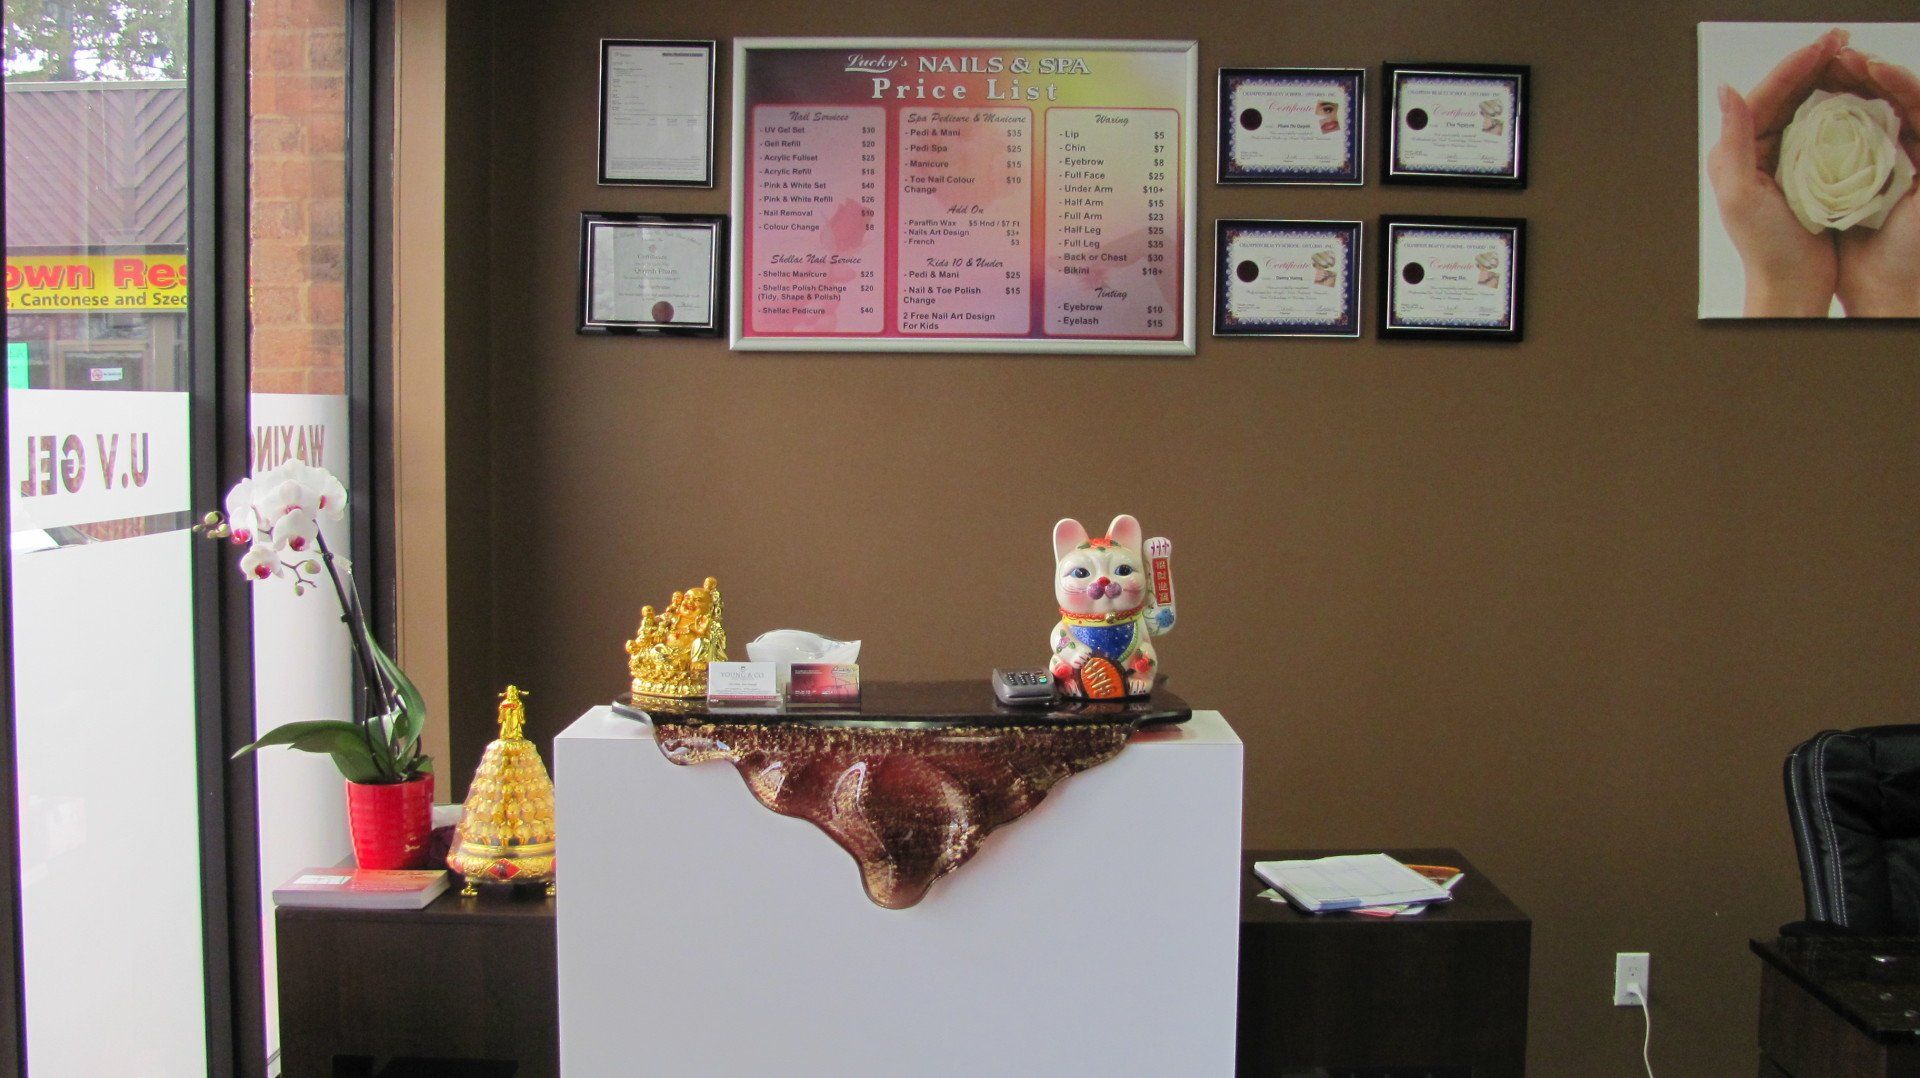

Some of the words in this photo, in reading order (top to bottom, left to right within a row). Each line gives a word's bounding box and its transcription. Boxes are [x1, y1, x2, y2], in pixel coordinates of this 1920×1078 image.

[845, 53, 908, 74] Lucky's
[918, 56, 1004, 74] NAILS
[1010, 57, 1032, 74] &
[1039, 57, 1091, 74] SPA
[872, 78, 967, 99] Price
[987, 78, 1057, 100] List
[789, 111, 809, 121] Nail
[813, 112, 848, 121] Services
[908, 113, 927, 124] Spa
[931, 113, 969, 123] Pedicure
[973, 113, 981, 122] &
[982, 113, 1026, 123] Manicure
[1095, 114, 1129, 126] Waxing
[1065, 131, 1079, 139] Lip
[931, 145, 947, 153] Spa
[1007, 145, 1022, 153] $25
[1065, 144, 1086, 152] Chin
[1154, 145, 1164, 153] $7
[1065, 158, 1104, 167] Eyebrow
[1154, 159, 1164, 167] $8
[1006, 176, 1021, 184] $10
[1148, 172, 1164, 180] $25
[904, 186, 937, 194] Change
[1064, 185, 1091, 193] Under
[1094, 185, 1113, 193] Arm
[1142, 186, 1164, 194] $10+
[1064, 199, 1082, 207] Half
[1084, 199, 1103, 207] Arm
[947, 204, 967, 214] Add
[970, 204, 984, 214] On
[1064, 212, 1081, 220] Full
[1083, 212, 1102, 220] Arm
[1148, 213, 1164, 221] $23
[791, 224, 819, 232] Change
[1064, 226, 1082, 234] Half
[1084, 226, 1101, 235] Leg
[1148, 227, 1164, 235] $25
[943, 229, 970, 237] Design
[1083, 240, 1100, 249] Leg
[770, 254, 803, 264] Shellac
[805, 253, 827, 264] Nail
[830, 254, 862, 264] Service
[1064, 253, 1086, 261] Back
[1101, 253, 1127, 261] Chest
[1147, 254, 1163, 262] $30
[926, 258, 949, 267] Kids
[952, 258, 962, 267] 10
[966, 258, 973, 267] &
[975, 258, 1003, 267] Under
[818, 285, 847, 293] Change
[1005, 287, 1021, 295] $15
[781, 294, 805, 302] Shape
[1094, 288, 1127, 300] Tinting
[21, 293, 109, 306] Cantonese
[115, 292, 146, 306] and
[903, 297, 936, 305] Change
[1063, 303, 1102, 312] Eyebrow
[1147, 306, 1163, 314] $10
[966, 313, 995, 321] Design
[1063, 317, 1099, 326] Eyelash
[1147, 320, 1163, 328] $15
